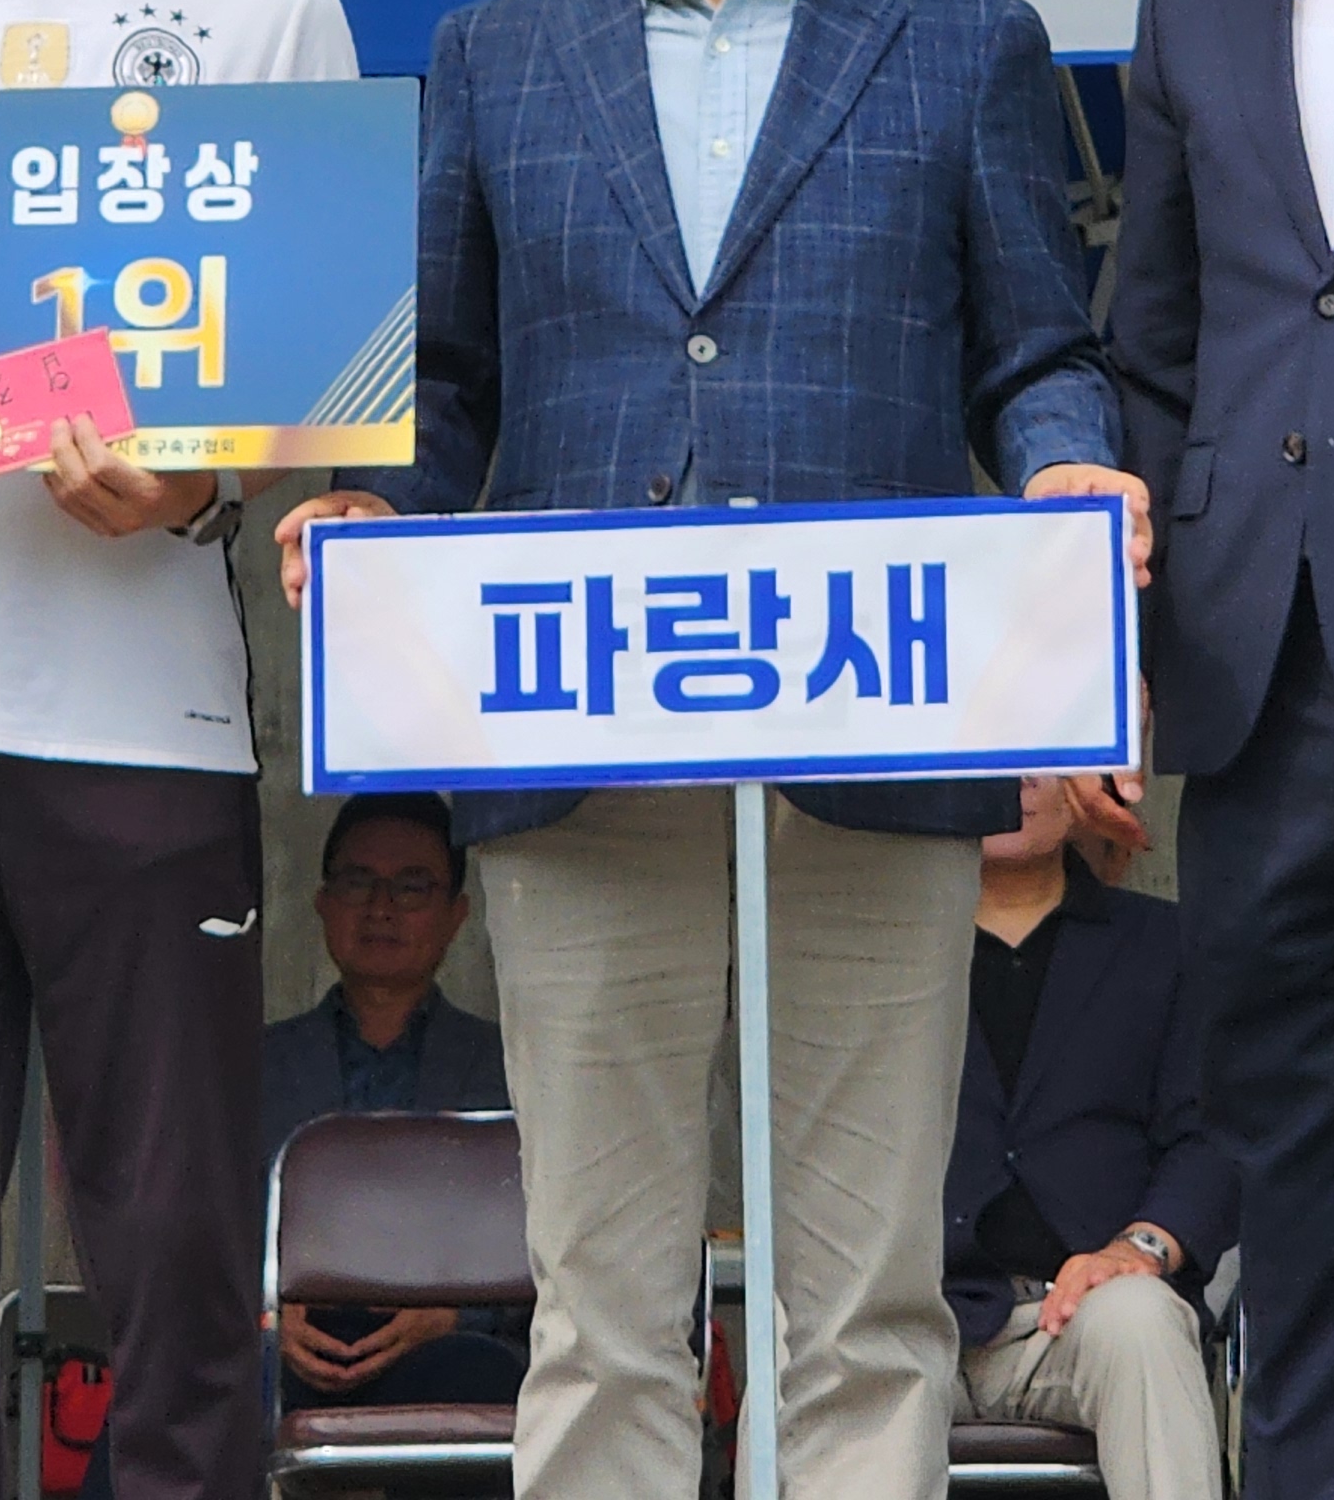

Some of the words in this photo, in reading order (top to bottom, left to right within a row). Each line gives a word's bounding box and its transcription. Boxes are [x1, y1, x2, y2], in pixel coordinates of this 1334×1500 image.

[11, 140, 260, 225] 입장상
[31, 255, 227, 388] 1위
[137, 438, 236, 457] 동구축구협회
[480, 561, 949, 716] 파랑새
